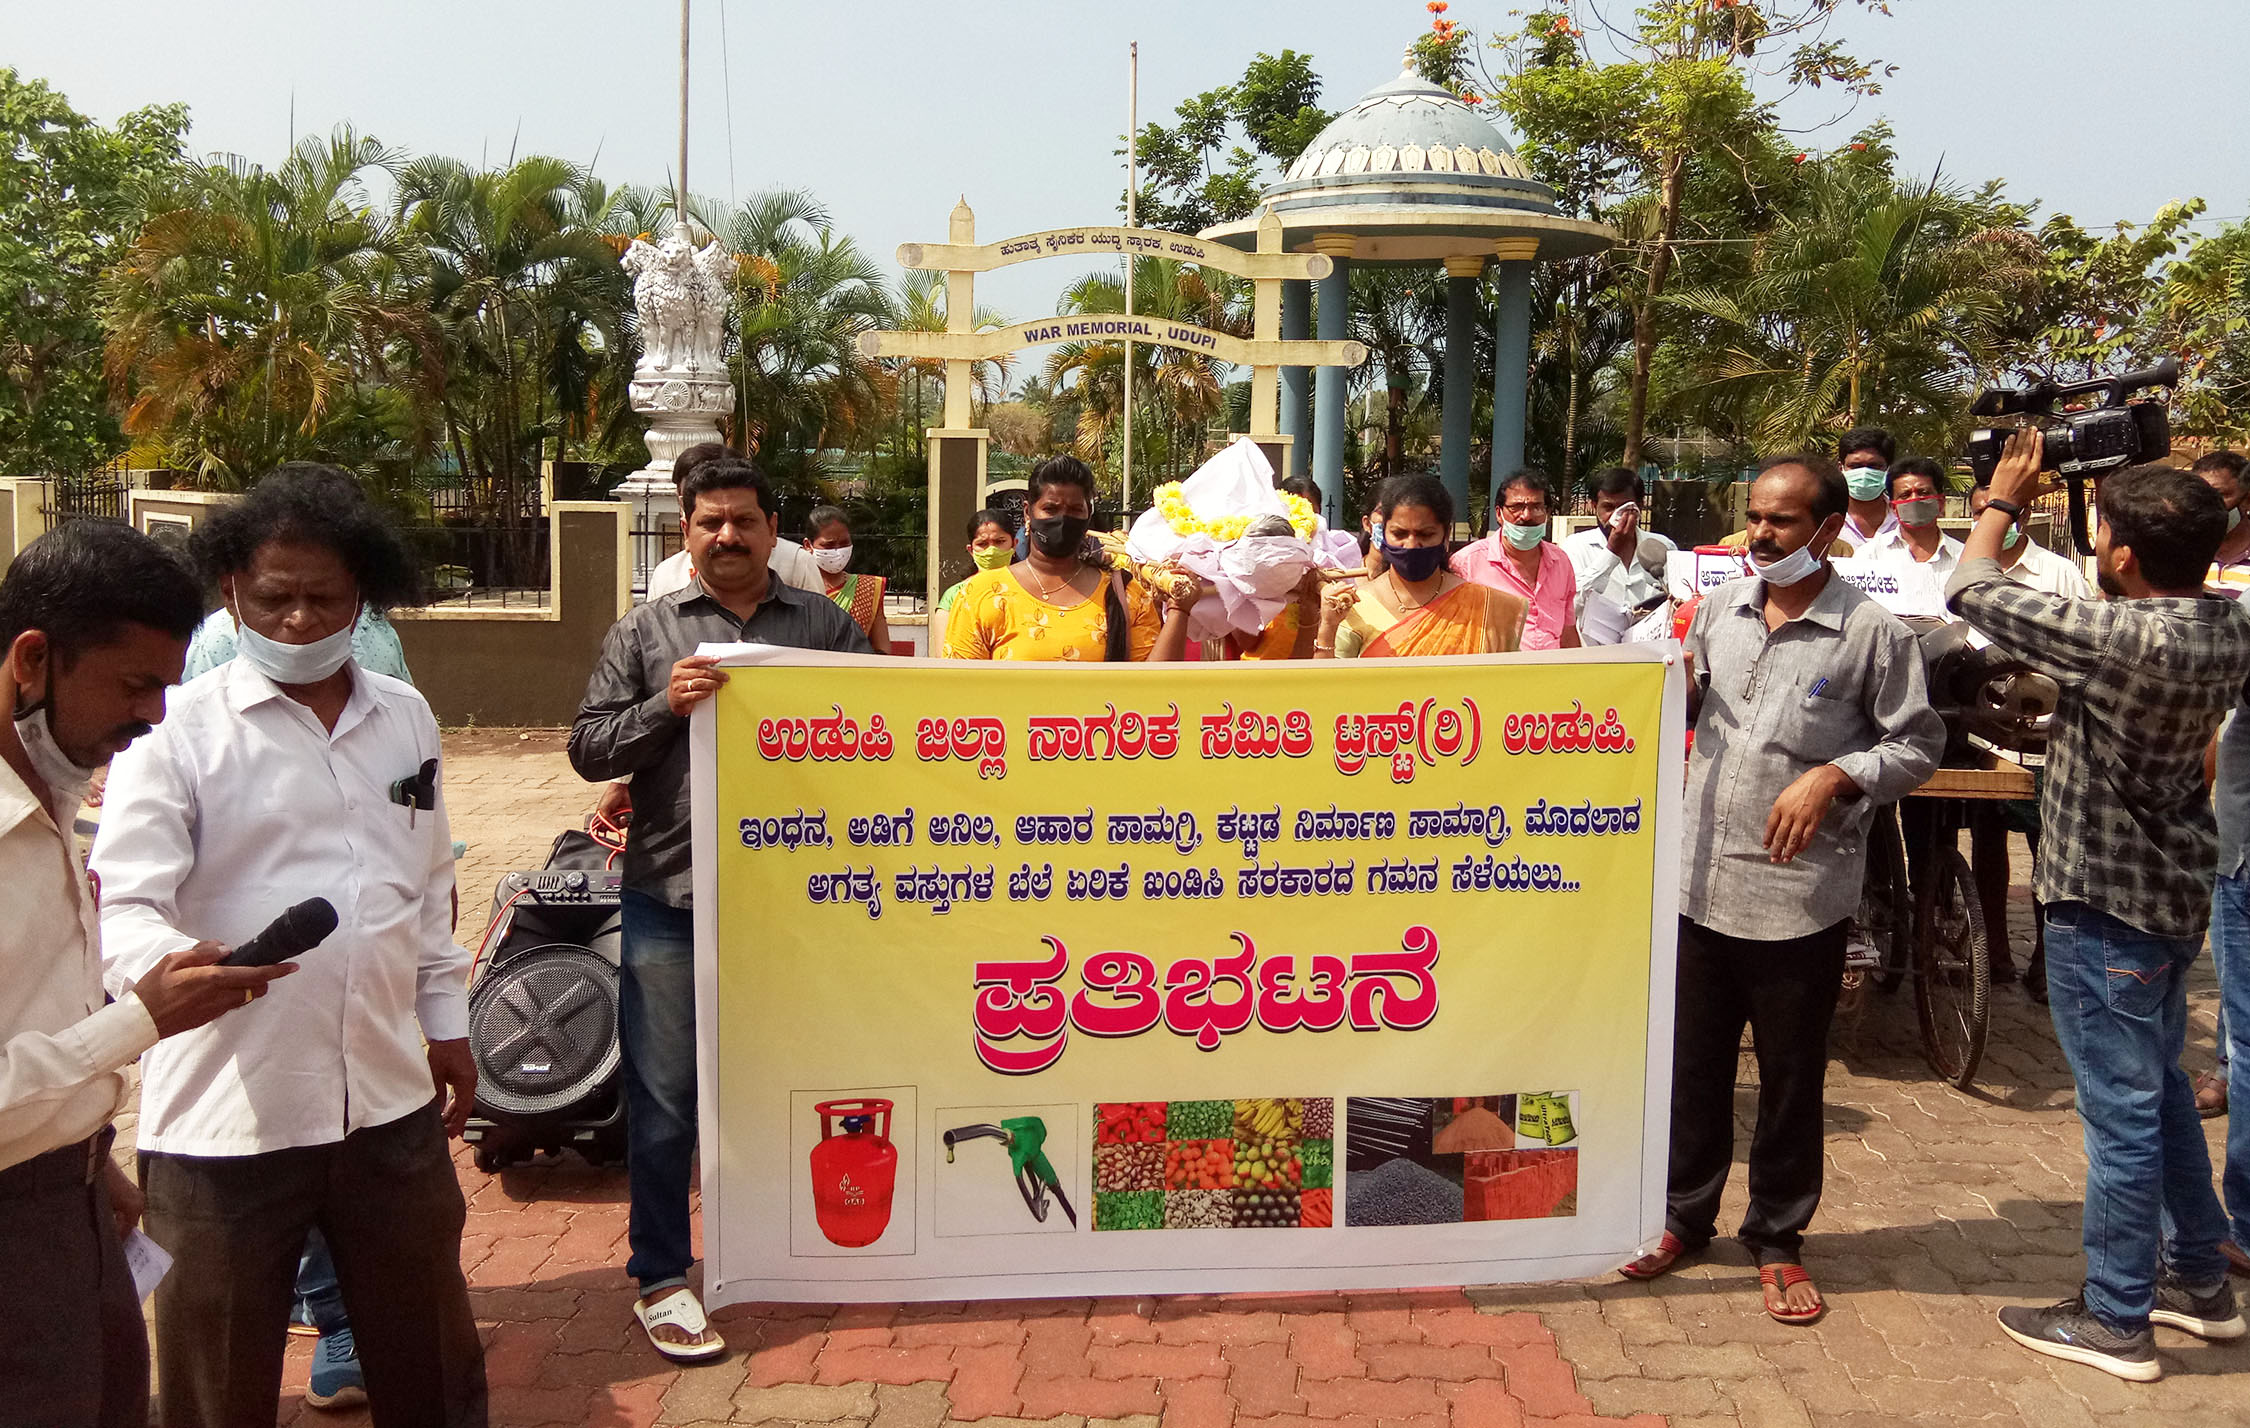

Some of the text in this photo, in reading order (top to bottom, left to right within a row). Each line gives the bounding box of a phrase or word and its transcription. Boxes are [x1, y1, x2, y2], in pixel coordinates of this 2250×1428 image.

[1046, 232, 1084, 251] ಸೈನಿಕರ
[1169, 242, 1205, 258] ಉಡುಪಿ
[1024, 325, 1062, 343] WAR
[1066, 321, 1152, 337] MEMORIAL
[1167, 326, 1216, 349] UDUPI
[756, 703, 895, 761] ಉಡುಪಿ
[915, 713, 1008, 780] ಜಿಲ್ಲಾ
[1027, 701, 1181, 761] ನಾಗರಿಕ
[1200, 701, 1314, 758] ಸಮಿತಿ
[739, 796, 1643, 860] ಇಂಧನ, ಅಡಿಗೆ ಅನಿಲ, ಆಹಾರ ಸಾಮಗ್ರಿ, ಕಟ್ಟಡ ನಿರ್ಮಾಣ ಸಾಮಾಗ್ರಿ, ಮೊದಲಾದ
[807, 863, 884, 920] ಅಗತ್ಯ
[894, 863, 995, 915] ವಸ್ತುಗಳ
[1007, 862, 1055, 902] ಬೆಲೆ
[1066, 861, 1132, 901] ಏರಿಕೆ
[1142, 866, 1226, 901] ಖಂಡಿಸಿ
[1237, 858, 1355, 898] ಸರಕಾರದ
[1366, 856, 1440, 895] ಗಮನ
[973, 924, 1441, 1076] ಪ್ರತಿಭಟನೆ
[648, 1309, 672, 1323] Sultan
